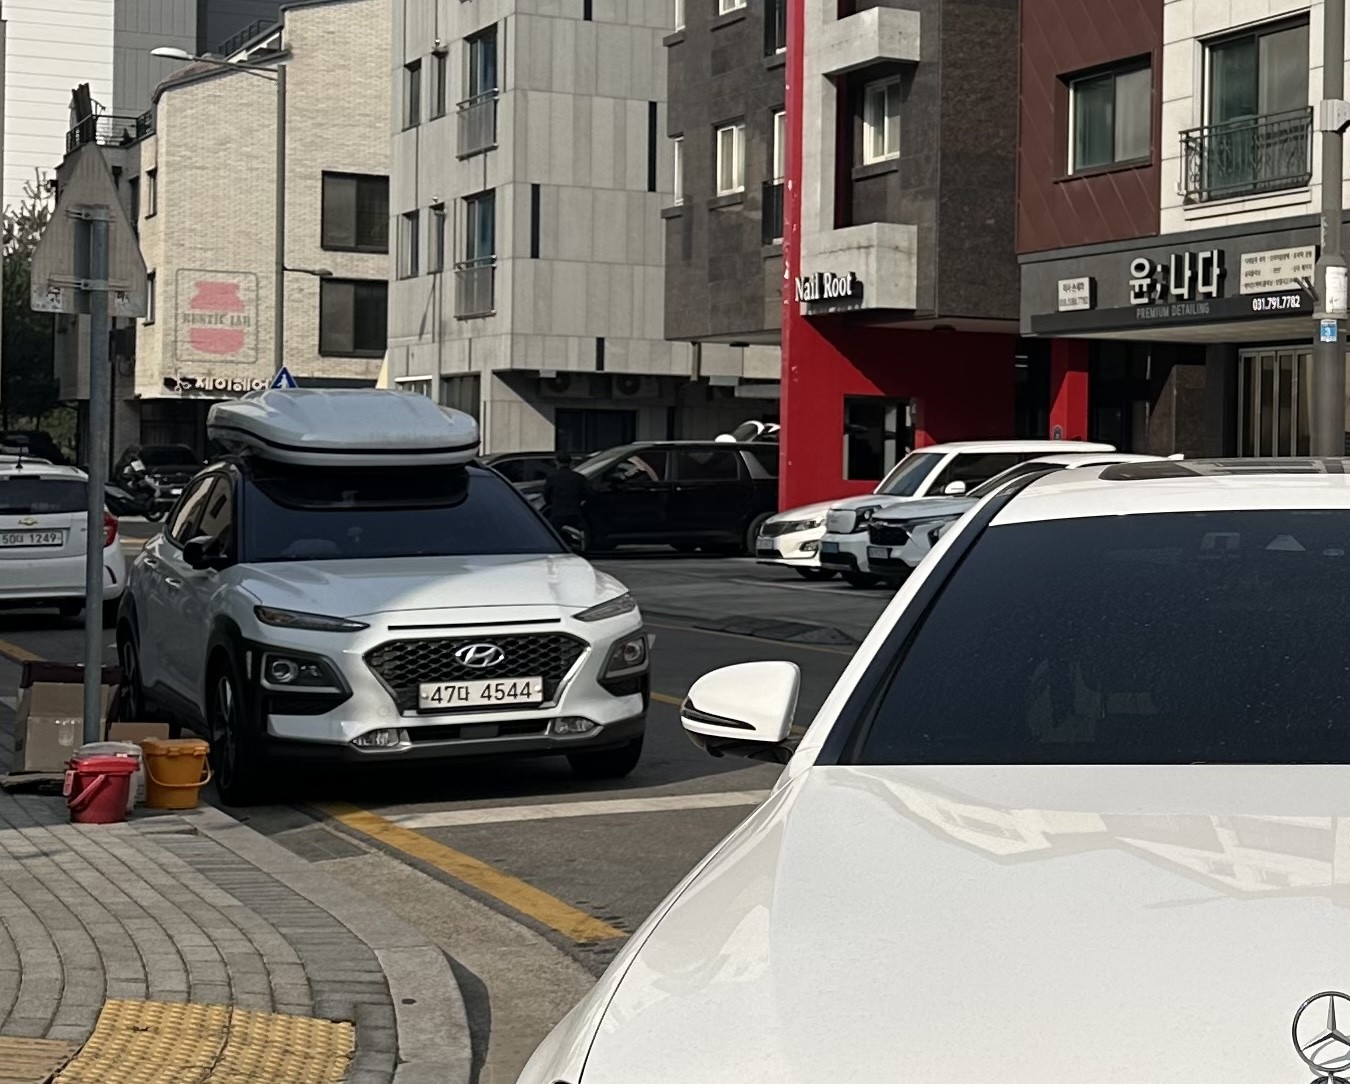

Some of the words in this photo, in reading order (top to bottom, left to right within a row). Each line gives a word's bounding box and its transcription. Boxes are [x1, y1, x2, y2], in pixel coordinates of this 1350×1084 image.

[794, 272, 820, 302] Nail
[823, 271, 852, 299] Root
[1136, 306, 1170, 320] PREMIUM
[1171, 302, 1210, 317] DETAILING
[430, 685, 470, 704] 47다
[480, 681, 532, 701] 4544
